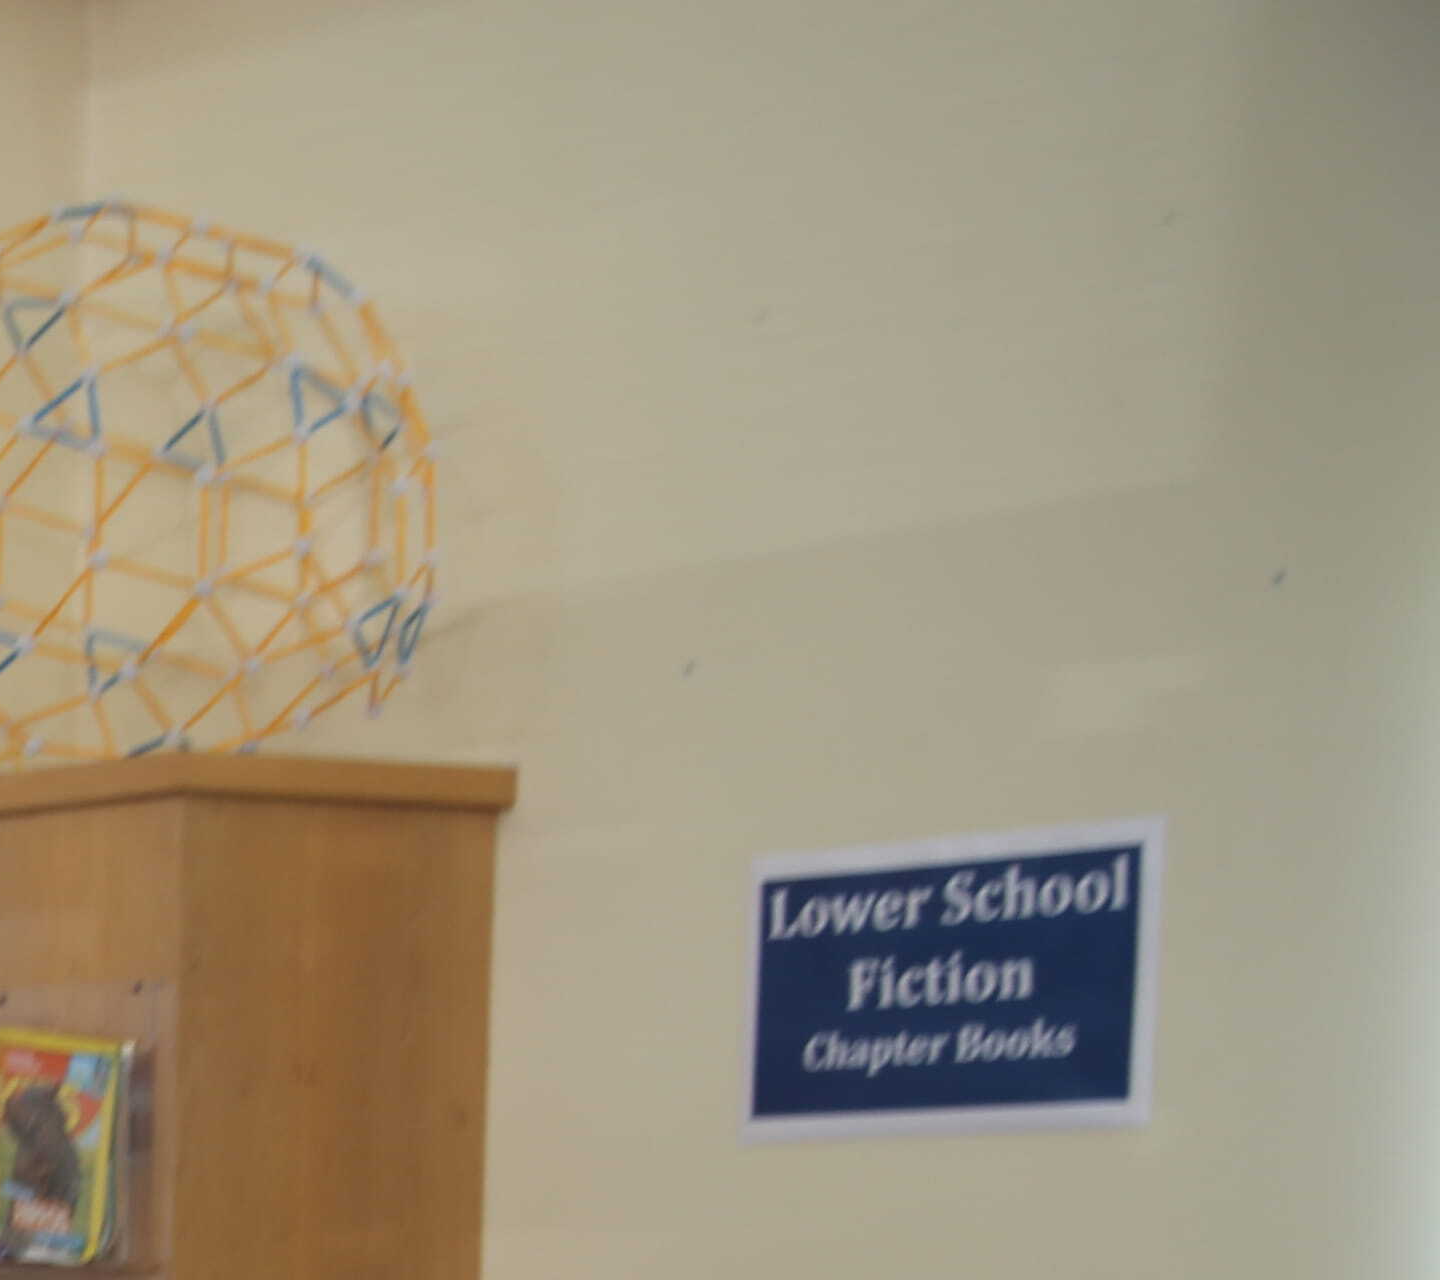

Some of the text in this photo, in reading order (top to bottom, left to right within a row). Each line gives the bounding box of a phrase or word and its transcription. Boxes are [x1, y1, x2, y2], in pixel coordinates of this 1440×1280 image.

[767, 853, 1129, 940] Lower School
[847, 950, 1034, 1012] Fiction
[803, 1019, 1076, 1077] Chapter Books
